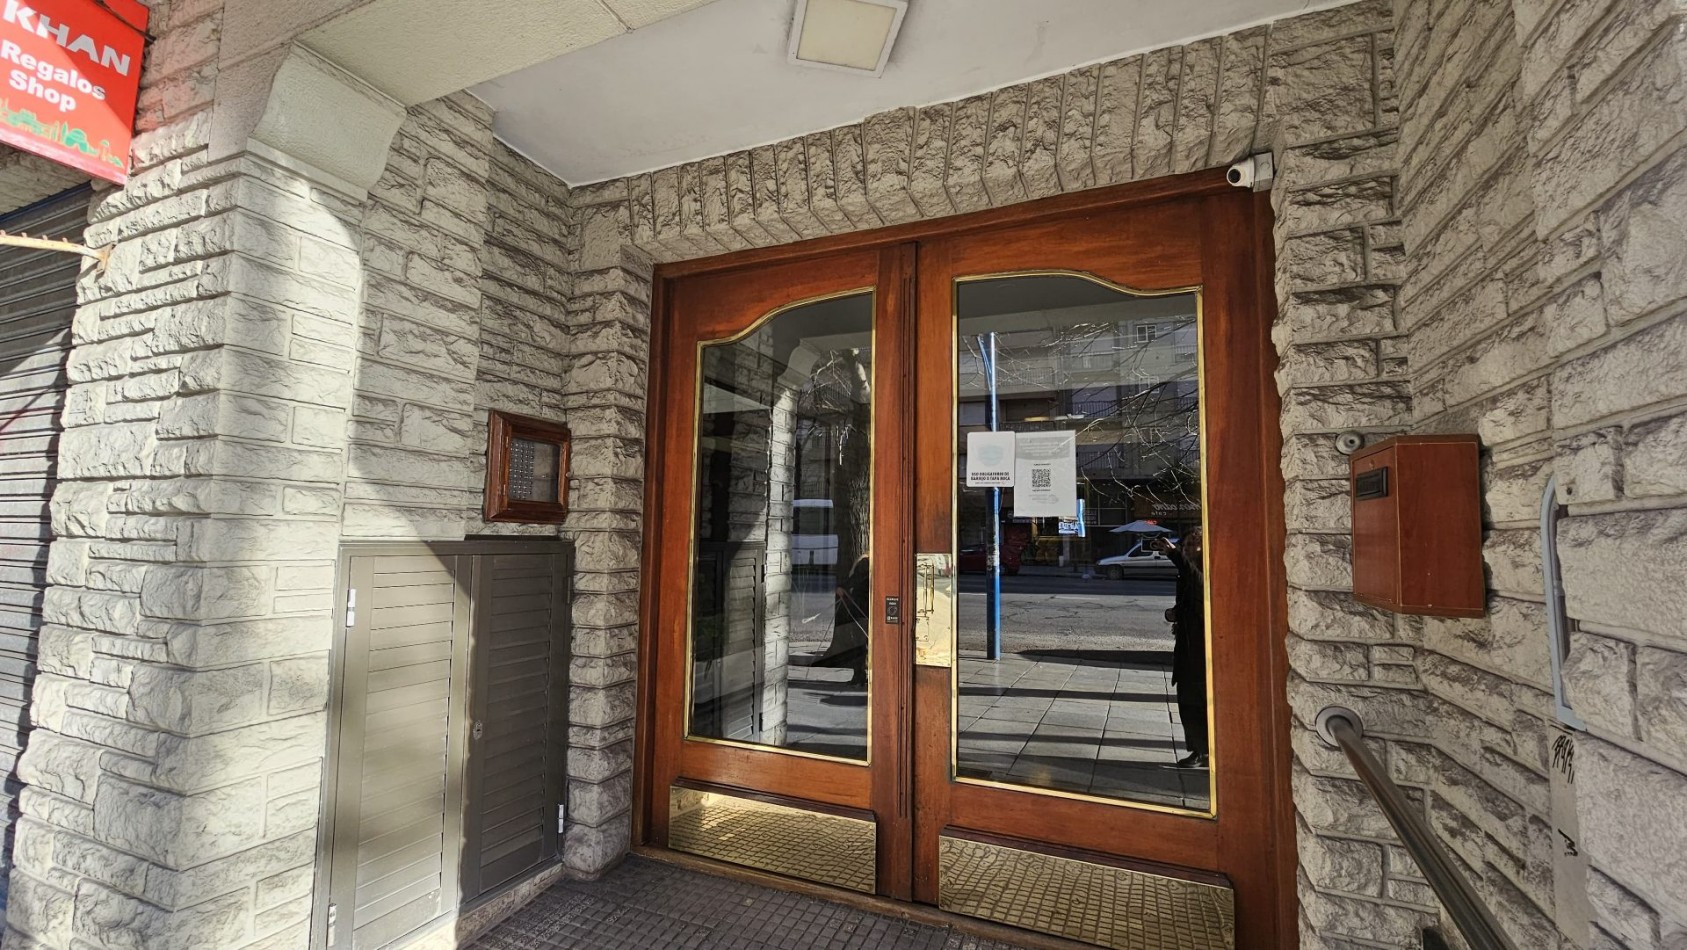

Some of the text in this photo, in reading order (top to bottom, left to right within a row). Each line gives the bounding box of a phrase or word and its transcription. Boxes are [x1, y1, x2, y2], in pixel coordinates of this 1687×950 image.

[3, 0, 130, 76] KHAN
[0, 39, 106, 100] Regalos
[9, 69, 77, 112] Shop
